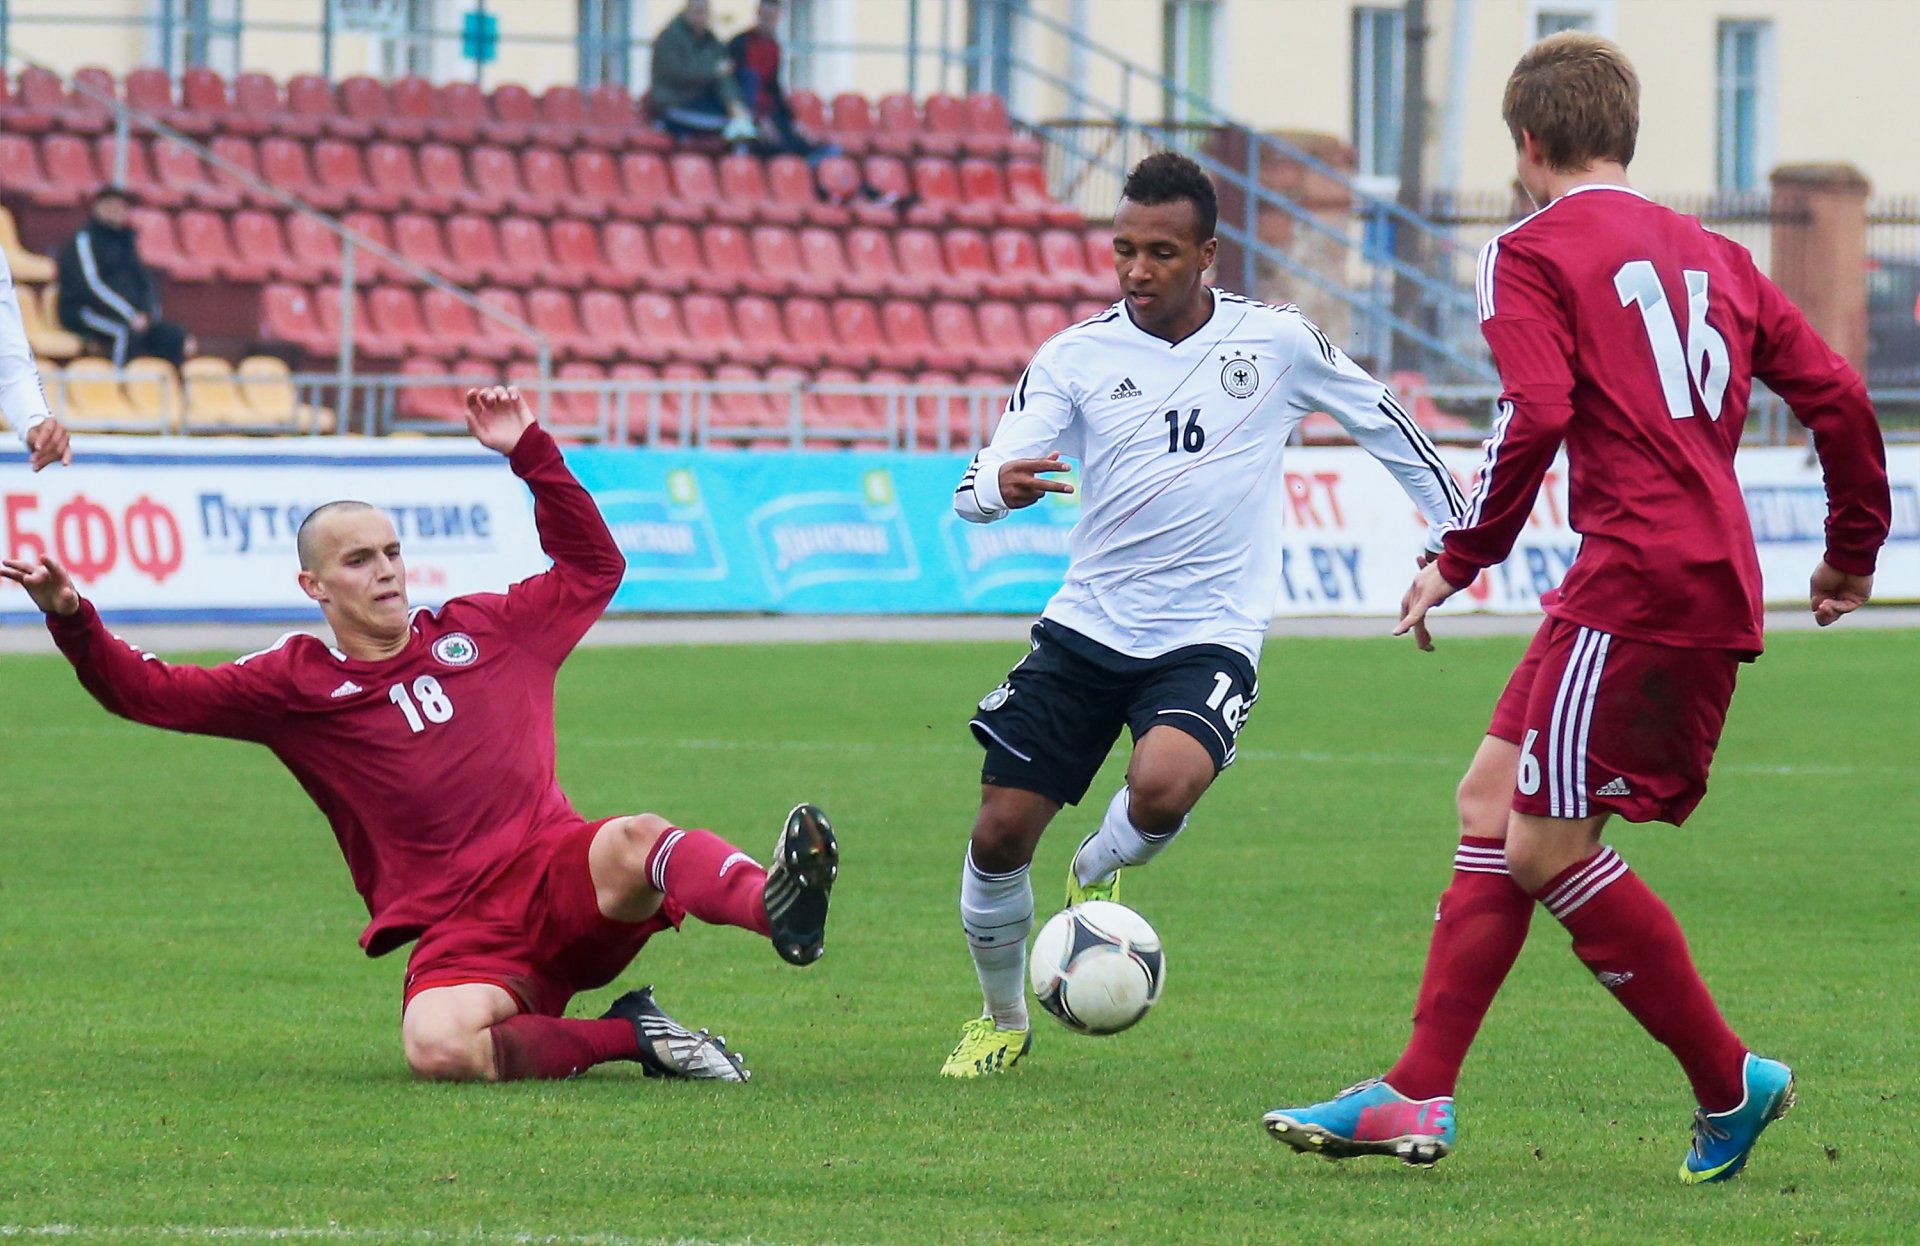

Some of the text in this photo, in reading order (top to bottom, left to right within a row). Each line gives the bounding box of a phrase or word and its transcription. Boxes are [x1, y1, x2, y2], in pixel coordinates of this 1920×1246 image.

[1612, 259, 1731, 422] 16
[1110, 388, 1143, 401] adidas
[1164, 408, 1206, 453] 16
[199, 493, 490, 553] Путетвие
[388, 674, 455, 734] 18
[1205, 671, 1244, 733] 16
[1352, 1100, 1447, 1142] NIKE
